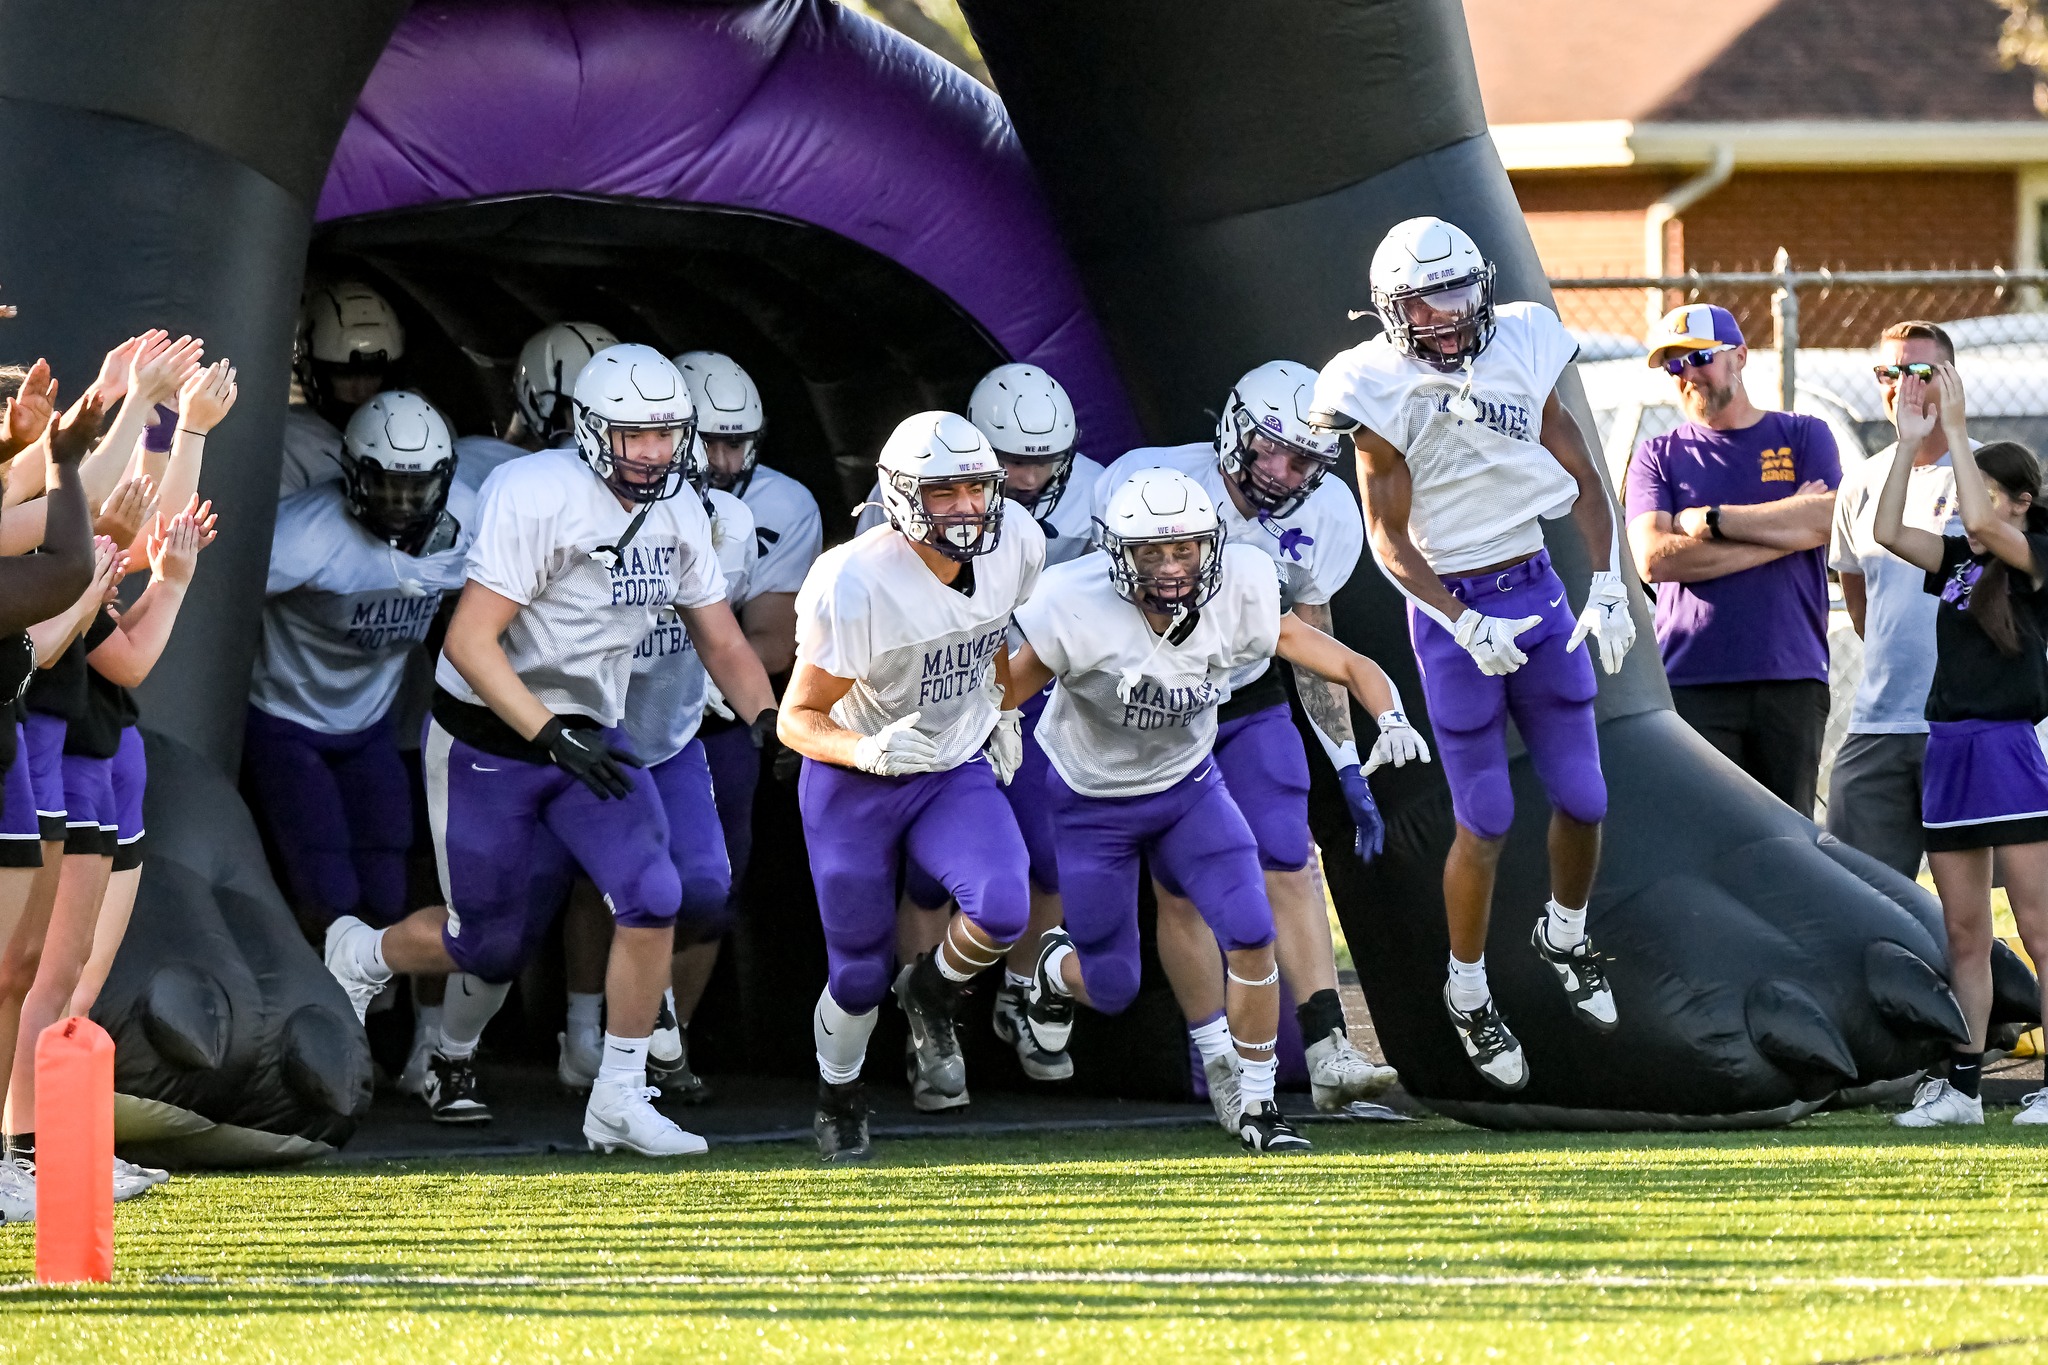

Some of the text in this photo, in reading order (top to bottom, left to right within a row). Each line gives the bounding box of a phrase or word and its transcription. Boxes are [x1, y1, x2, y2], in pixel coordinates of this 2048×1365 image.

[1427, 268, 1455, 281] WE ARE
[651, 412, 675, 421] WE ARE
[1295, 434, 1320, 449] WE ARE
[958, 463, 971, 471] WE
[350, 593, 440, 626] MAUME
